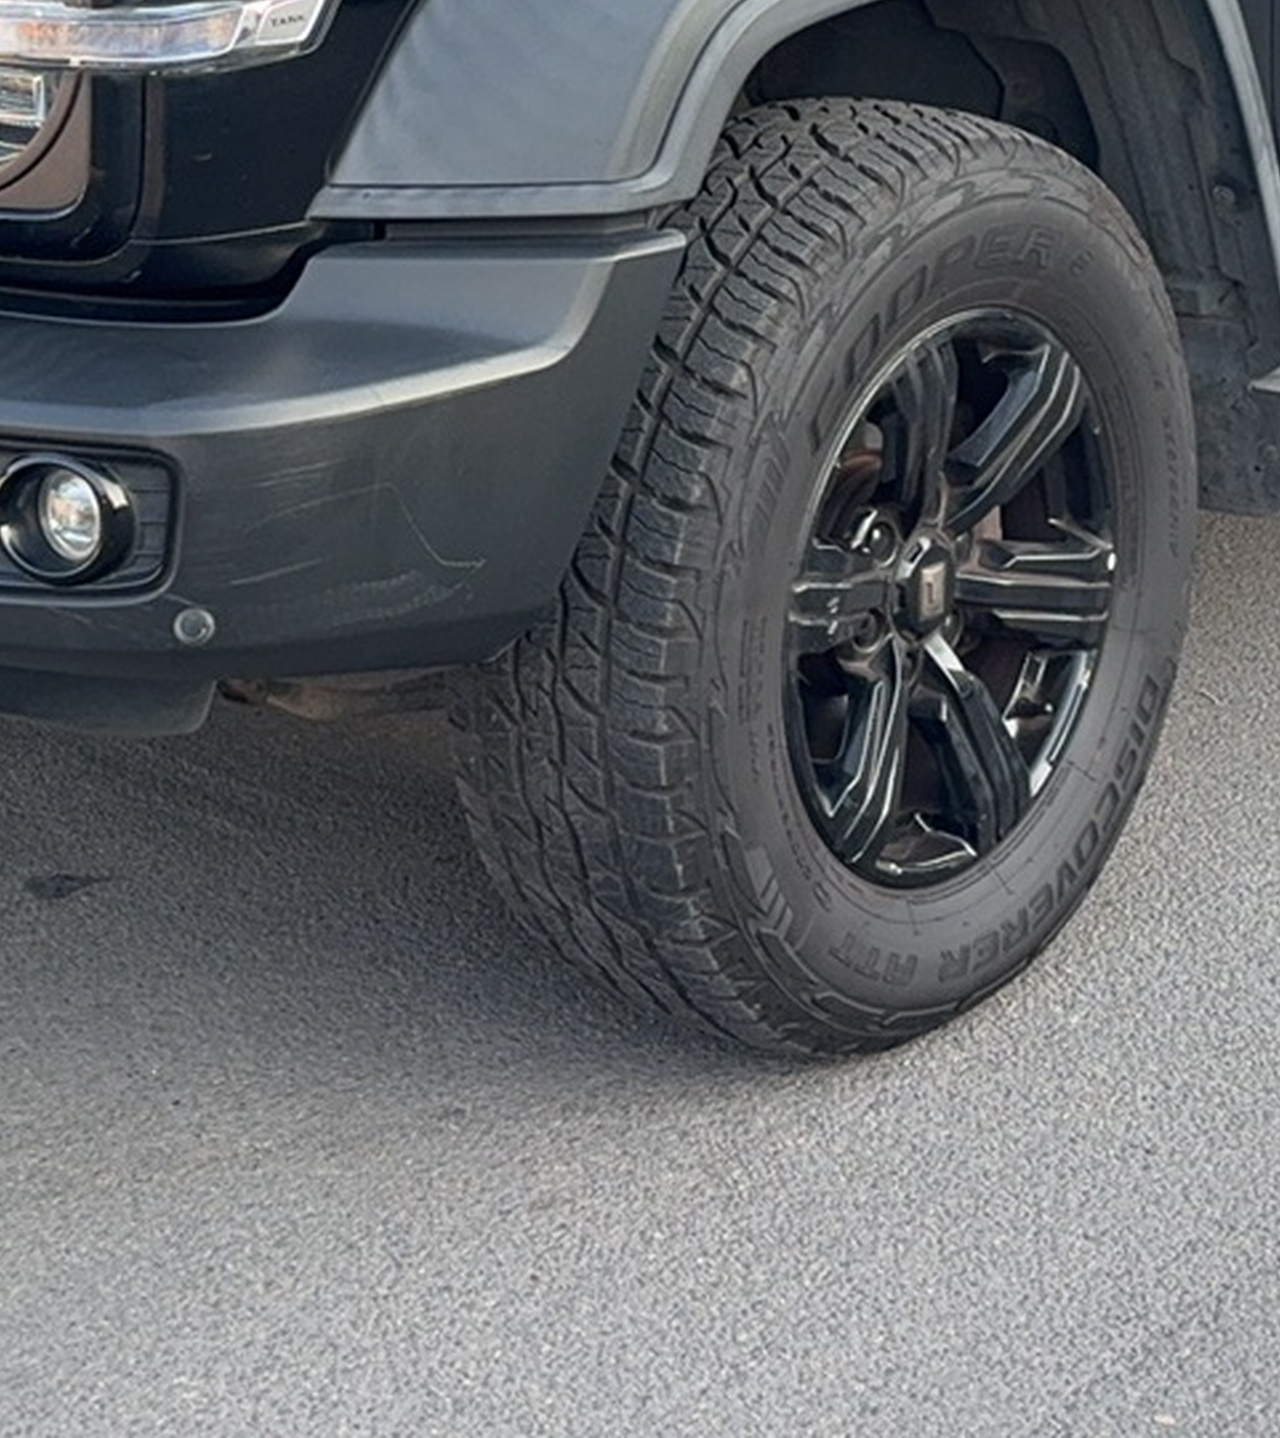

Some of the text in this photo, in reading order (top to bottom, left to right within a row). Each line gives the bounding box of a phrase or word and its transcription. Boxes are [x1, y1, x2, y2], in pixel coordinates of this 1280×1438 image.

[810, 222, 1064, 455] COOPER
[937, 671, 1161, 984] DISCOVERER
[828, 930, 919, 987] ATT
